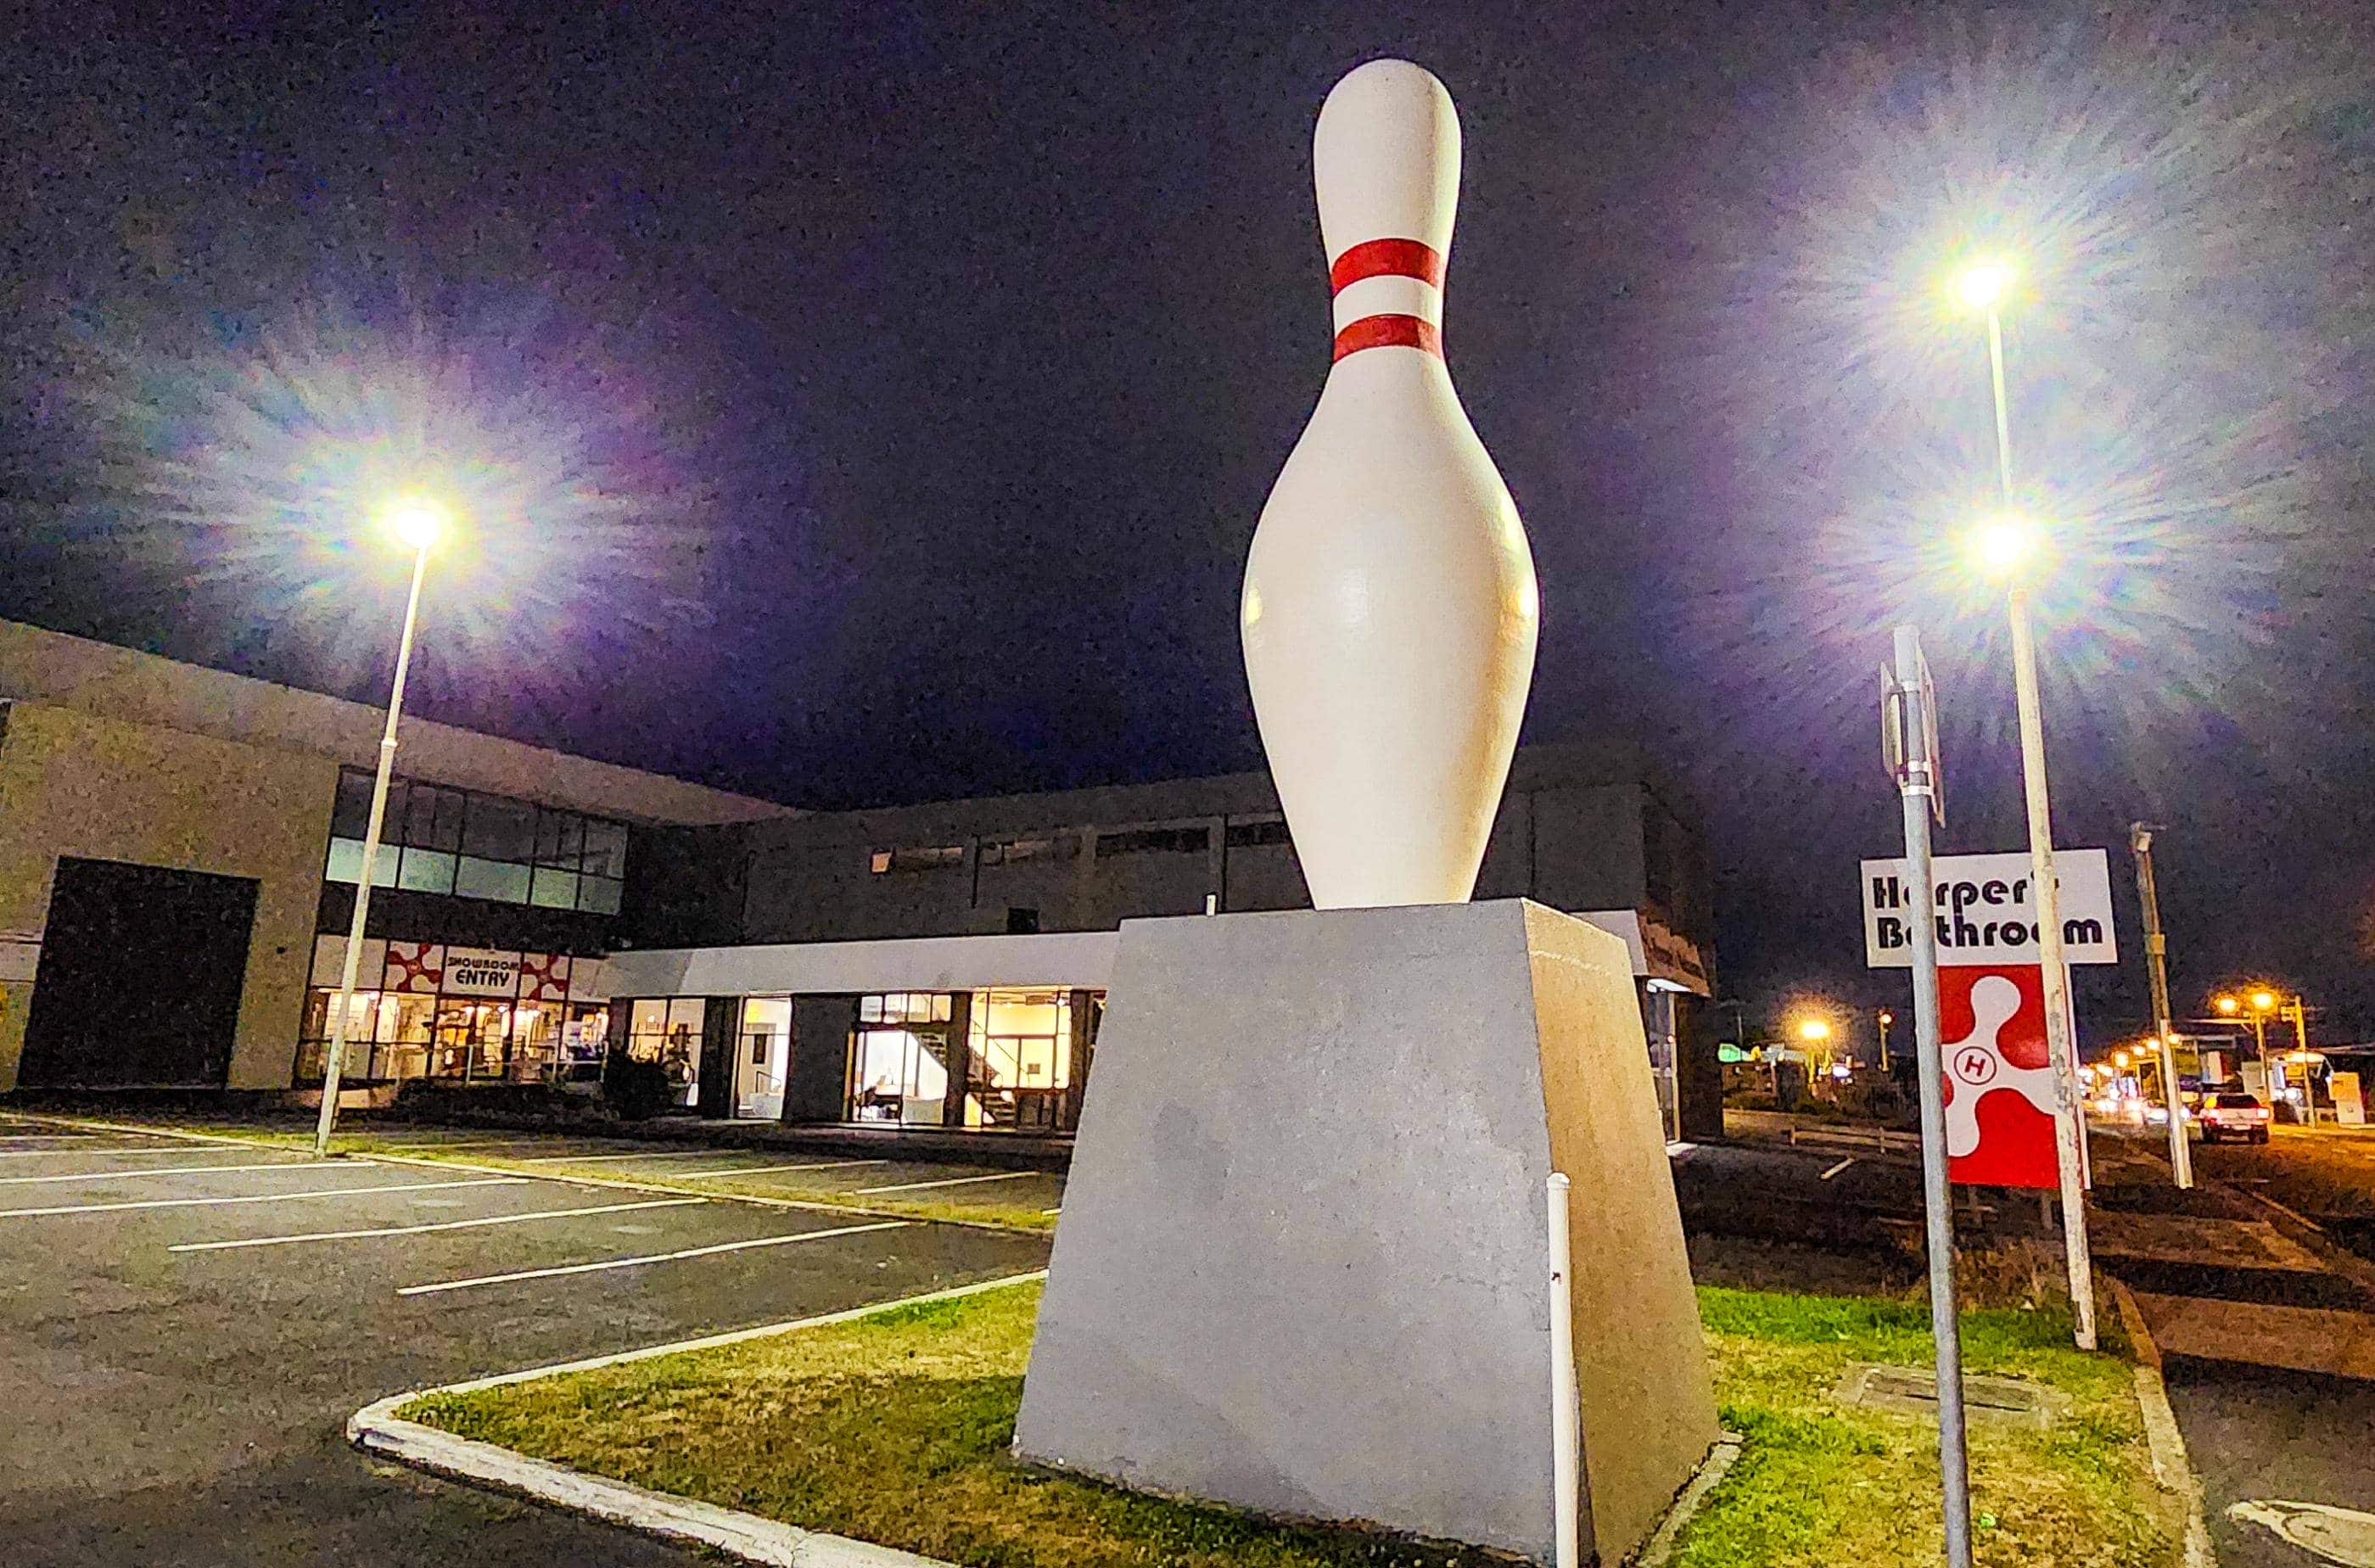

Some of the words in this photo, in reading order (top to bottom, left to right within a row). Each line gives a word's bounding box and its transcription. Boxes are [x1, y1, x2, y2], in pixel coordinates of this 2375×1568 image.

[1873, 870, 2059, 914] Hrper
[1878, 915, 2103, 949] Bthrom
[447, 956, 519, 970] SHOWROOM
[456, 969, 510, 987] ENTRY
[1964, 1055, 1986, 1077] H
